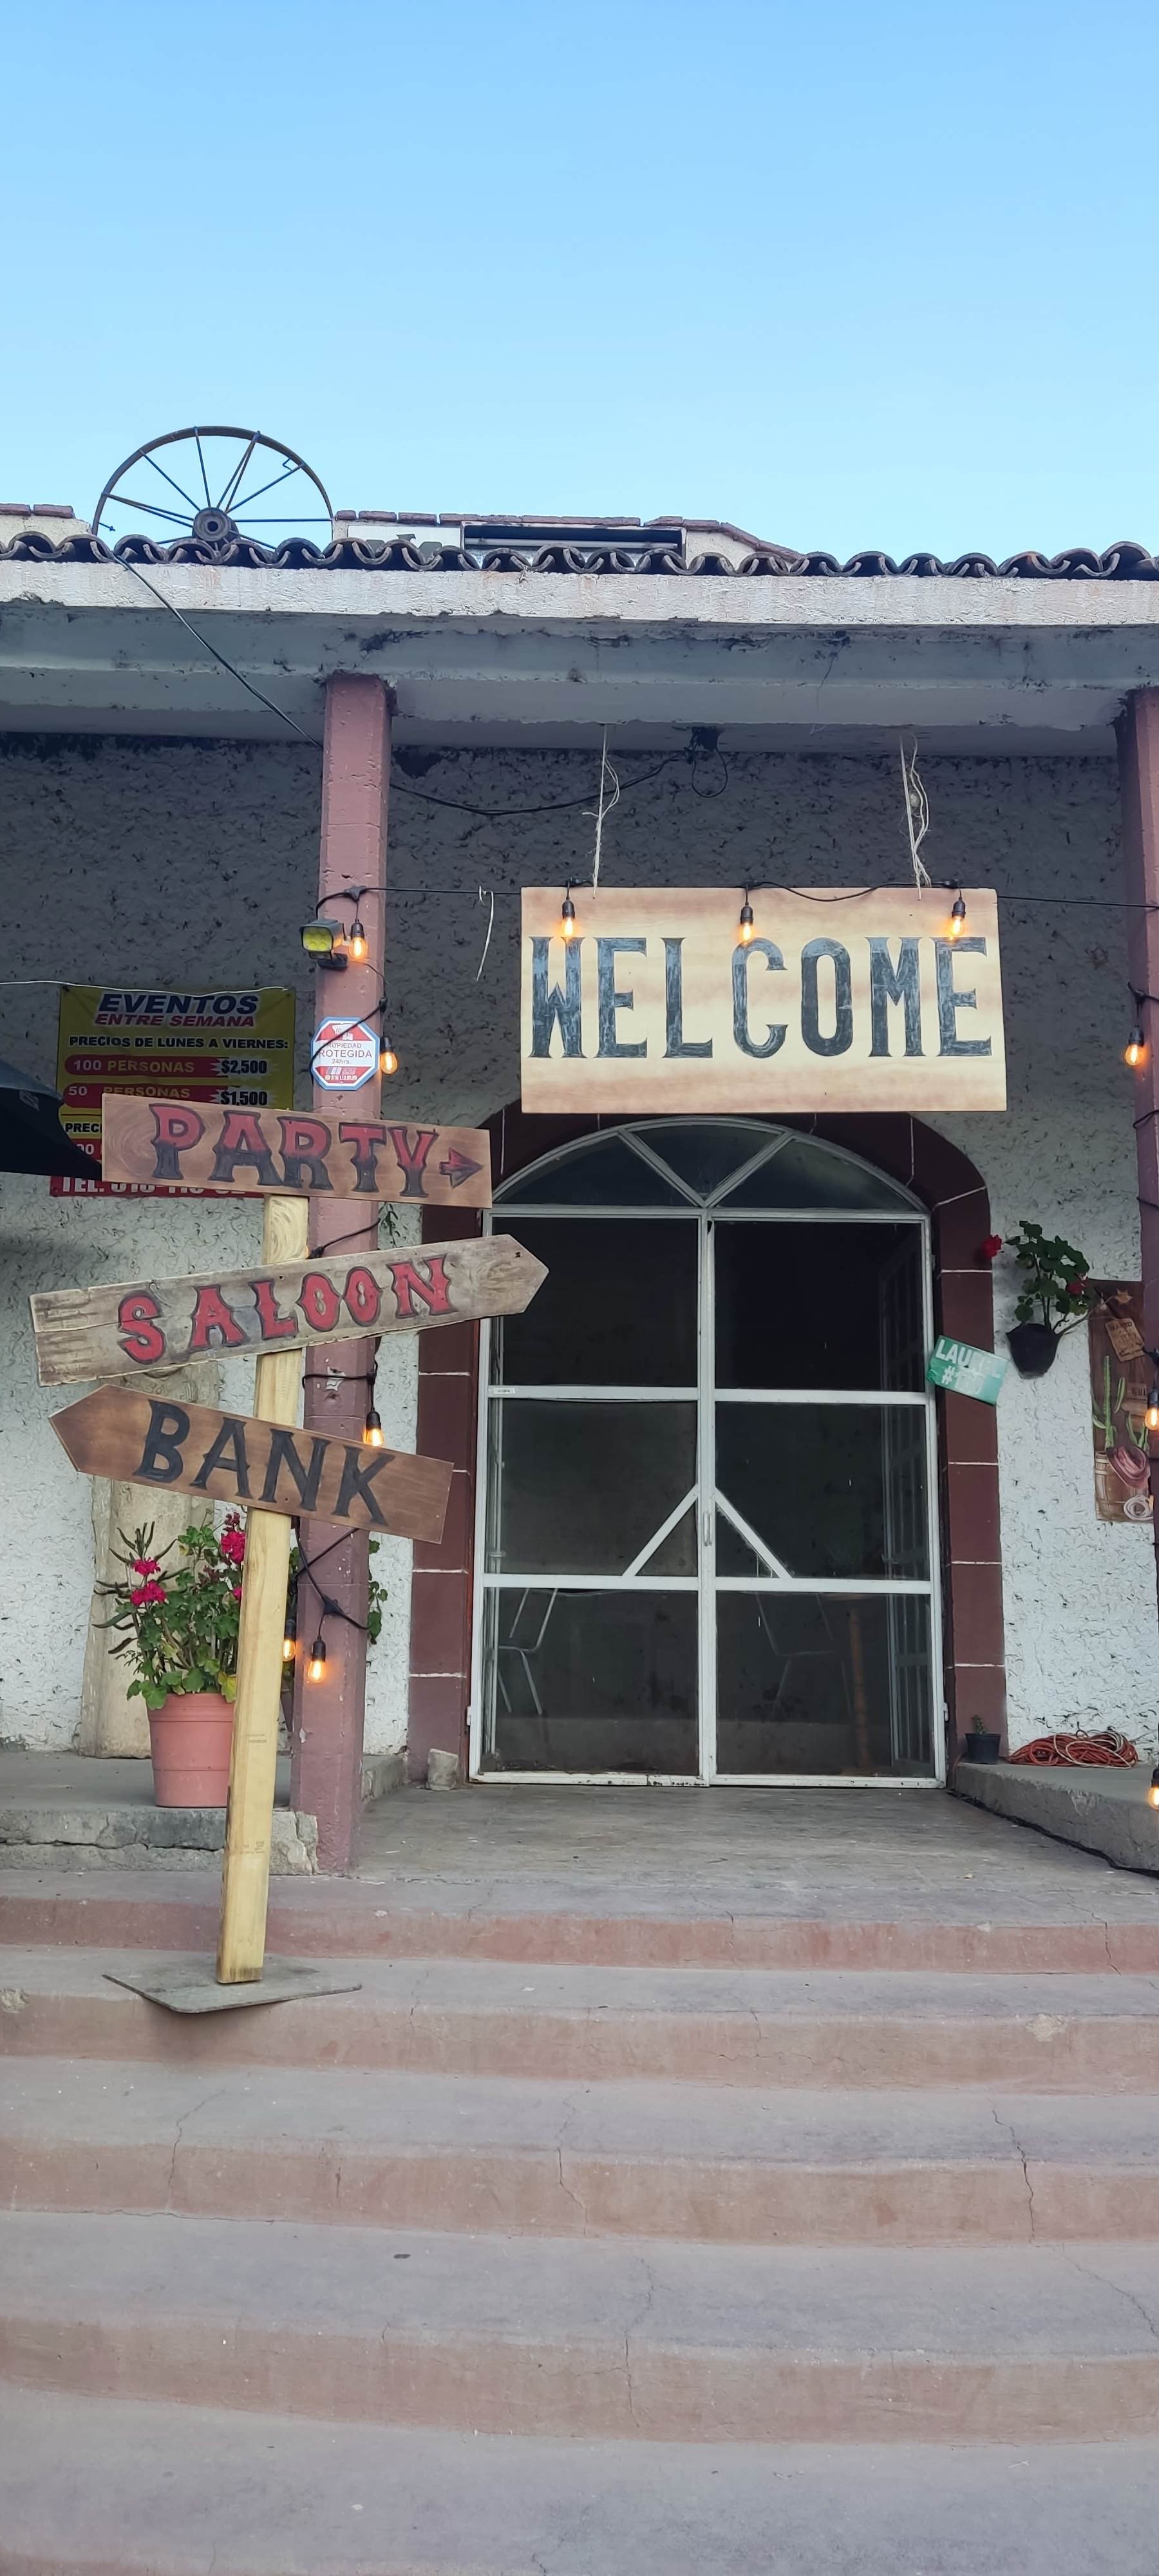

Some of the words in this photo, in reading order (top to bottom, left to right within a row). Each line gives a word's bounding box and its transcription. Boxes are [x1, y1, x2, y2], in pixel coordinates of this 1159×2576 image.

[99, 994, 258, 1014] EVENTOS
[527, 936, 993, 1059] WELCOME
[95, 1014, 163, 1026] ENTRE
[169, 1015, 255, 1027] SEMANA
[69, 1036, 130, 1048] PRECIOS
[135, 1037, 153, 1048] DE
[157, 1038, 204, 1048] LUNES
[208, 1038, 219, 1048] A
[222, 1038, 288, 1049] VIERNES:
[319, 1050, 373, 1058] ROTEGIDA
[73, 1060, 102, 1071] 100
[107, 1060, 194, 1073] PERSONAS
[220, 1059, 267, 1074] $2,500
[68, 1086, 88, 1096] 50
[103, 1086, 191, 1098] PERSONAS
[220, 1090, 268, 1106] $1,500
[65, 1122, 102, 1133] PRECI
[148, 1103, 438, 1197] PARTY
[117, 1253, 459, 1365] SALOON
[133, 1398, 396, 1527] BANK
